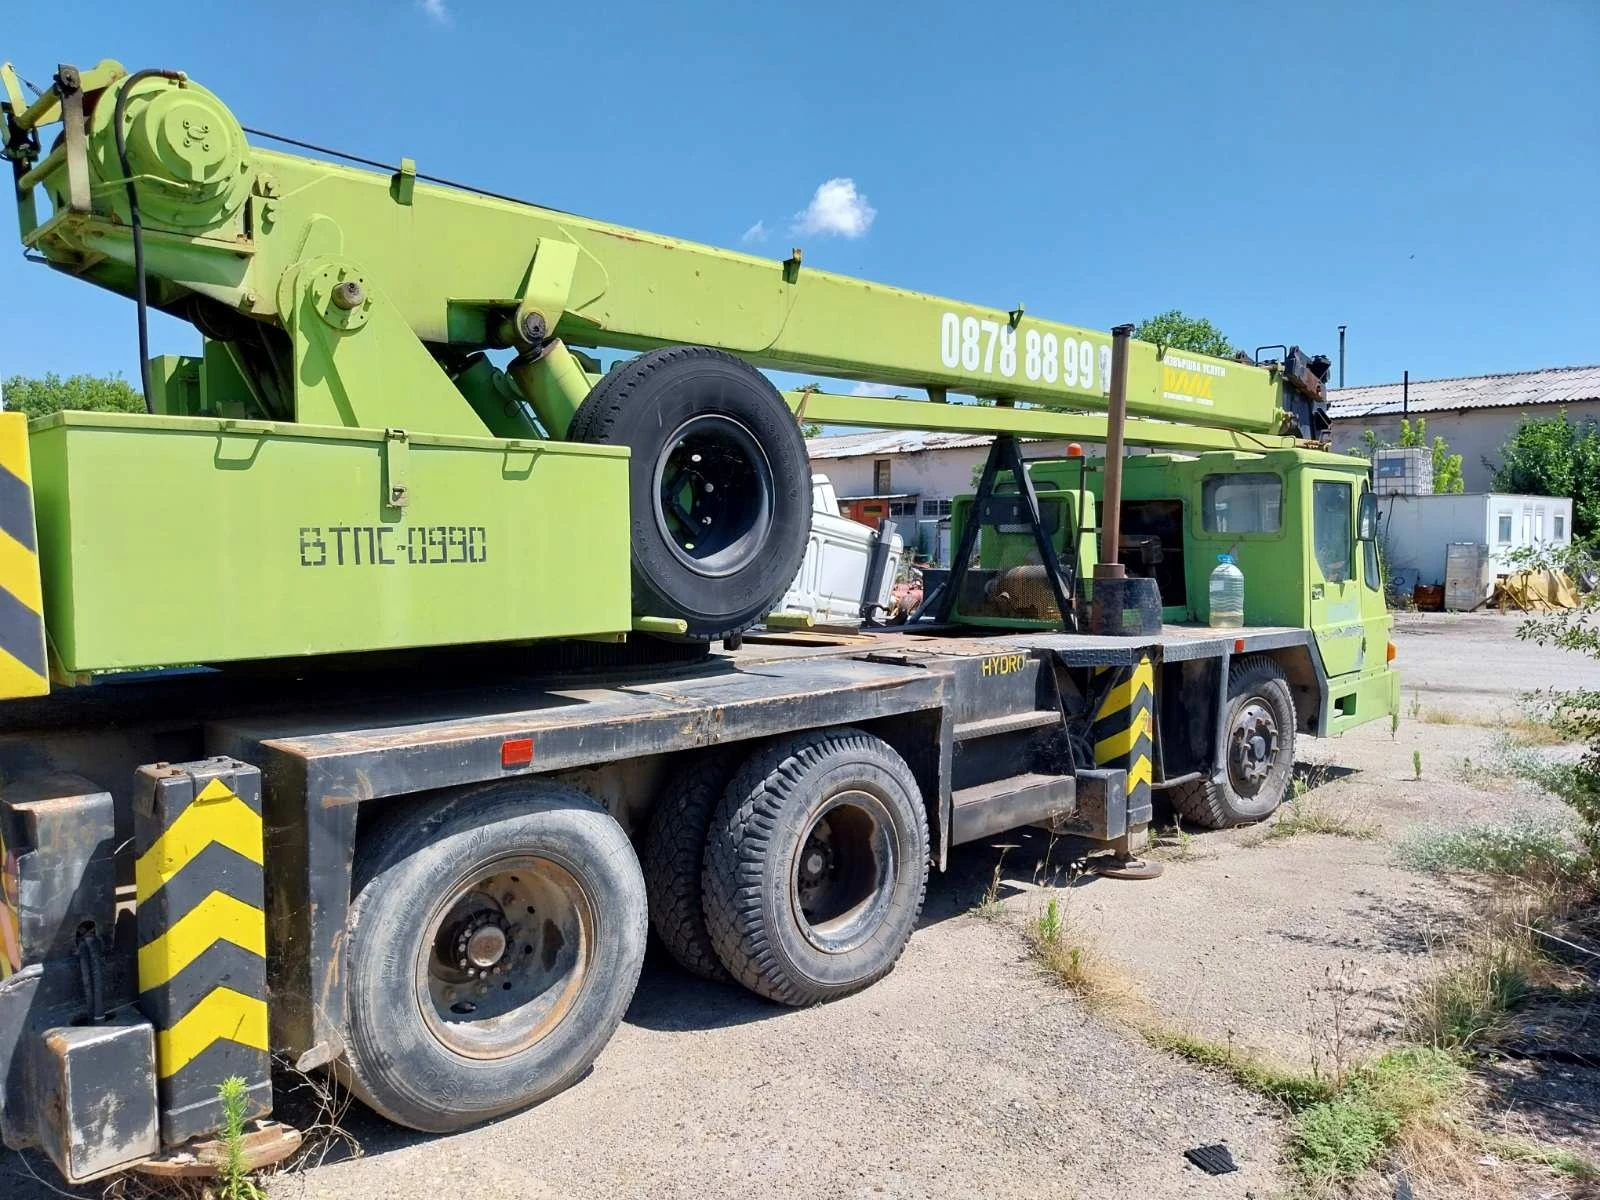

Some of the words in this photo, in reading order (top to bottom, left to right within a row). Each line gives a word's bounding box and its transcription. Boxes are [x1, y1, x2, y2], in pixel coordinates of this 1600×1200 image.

[941, 312, 1017, 378] 0878
[1025, 329, 1058, 384] 88
[1063, 336, 1094, 390] 99
[982, 655, 1026, 677] HYDRO
